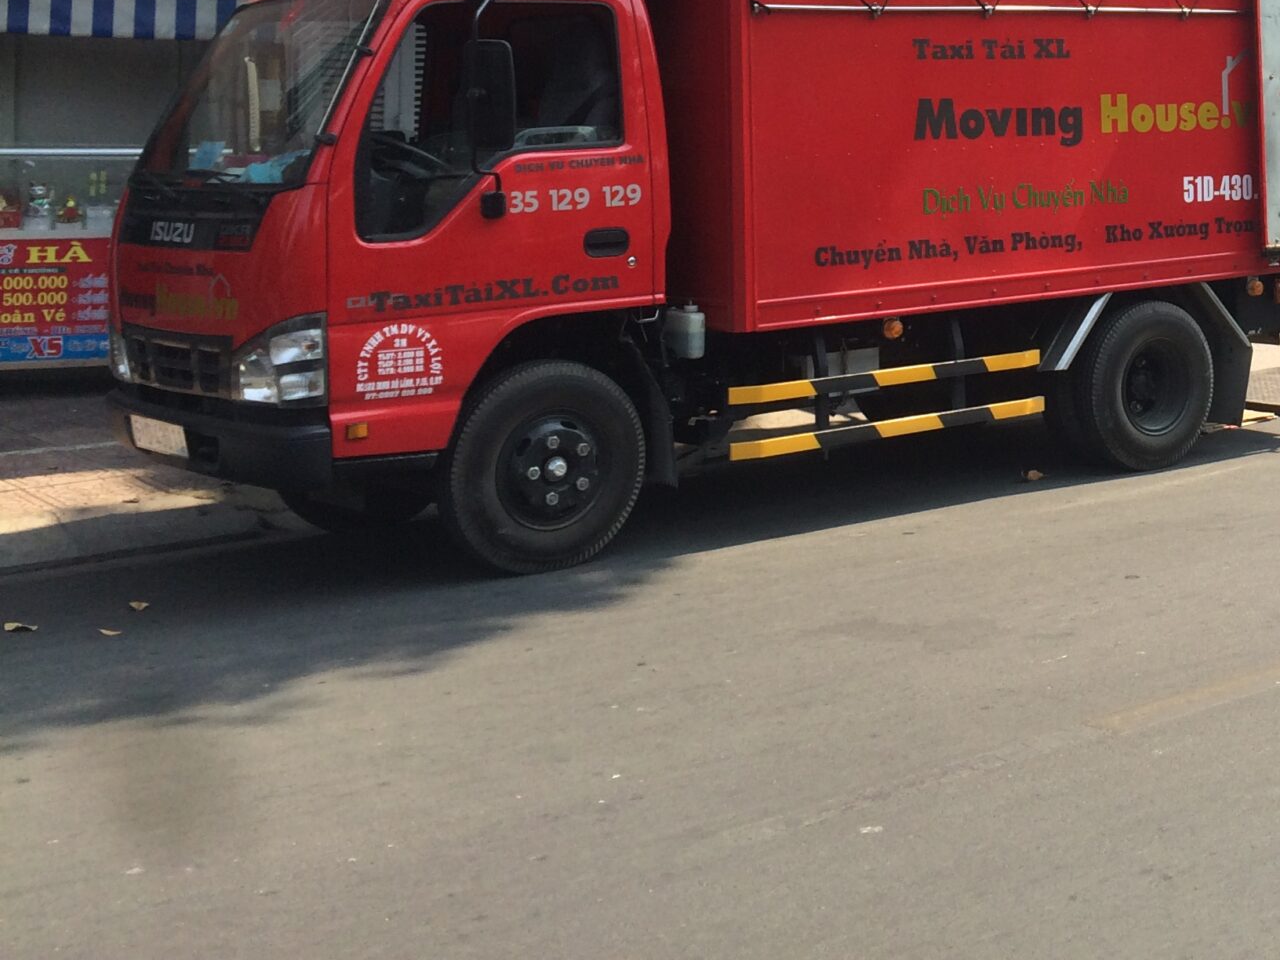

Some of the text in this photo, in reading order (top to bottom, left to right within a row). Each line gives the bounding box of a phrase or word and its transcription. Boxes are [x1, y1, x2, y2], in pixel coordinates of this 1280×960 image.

[912, 38, 974, 60] Taxi
[1033, 38, 1071, 59] XL
[913, 98, 1083, 147] Moving
[509, 183, 642, 214] 35 129 129
[923, 186, 970, 220] Dịch
[1089, 177, 1129, 204] Nhà
[1183, 174, 1258, 203] 51D-430.
[150, 221, 195, 244] ISUZU
[815, 239, 902, 270] Chuyển
[964, 235, 1004, 255] Văn
[1105, 223, 1143, 243] Kho
[25, 241, 93, 263] HÀ
[3, 291, 67, 306] 500.000
[0, 309, 35, 323] oàn
[42, 308, 66, 322] Vé
[357, 360, 369, 381] CTY
[383, 324, 399, 337] TM
[400, 323, 416, 335] DV
[416, 327, 431, 342] VT
